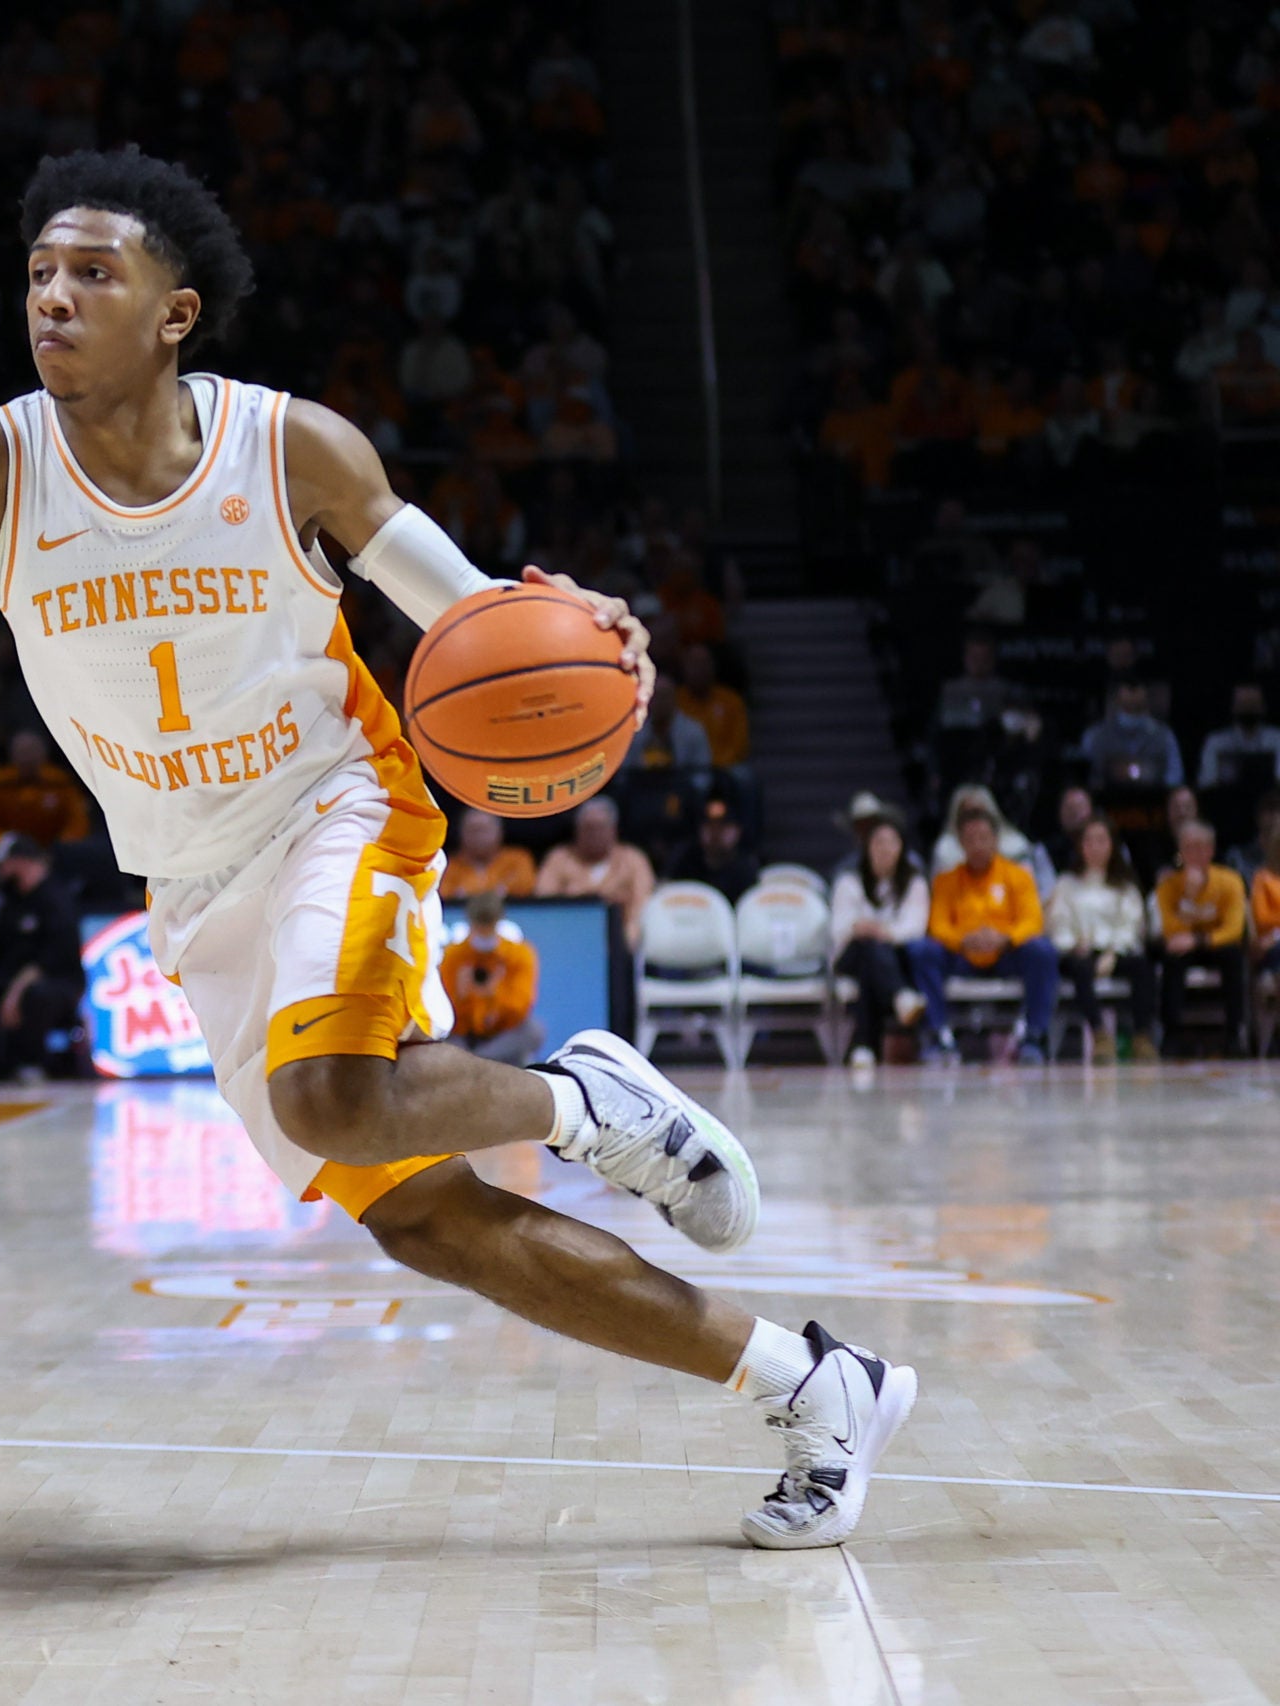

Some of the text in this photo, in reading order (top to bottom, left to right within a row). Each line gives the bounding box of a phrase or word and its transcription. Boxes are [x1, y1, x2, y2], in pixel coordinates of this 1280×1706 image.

[222, 497, 248, 523] SEC
[32, 567, 269, 636] TENNESSEE
[148, 641, 191, 733] 1
